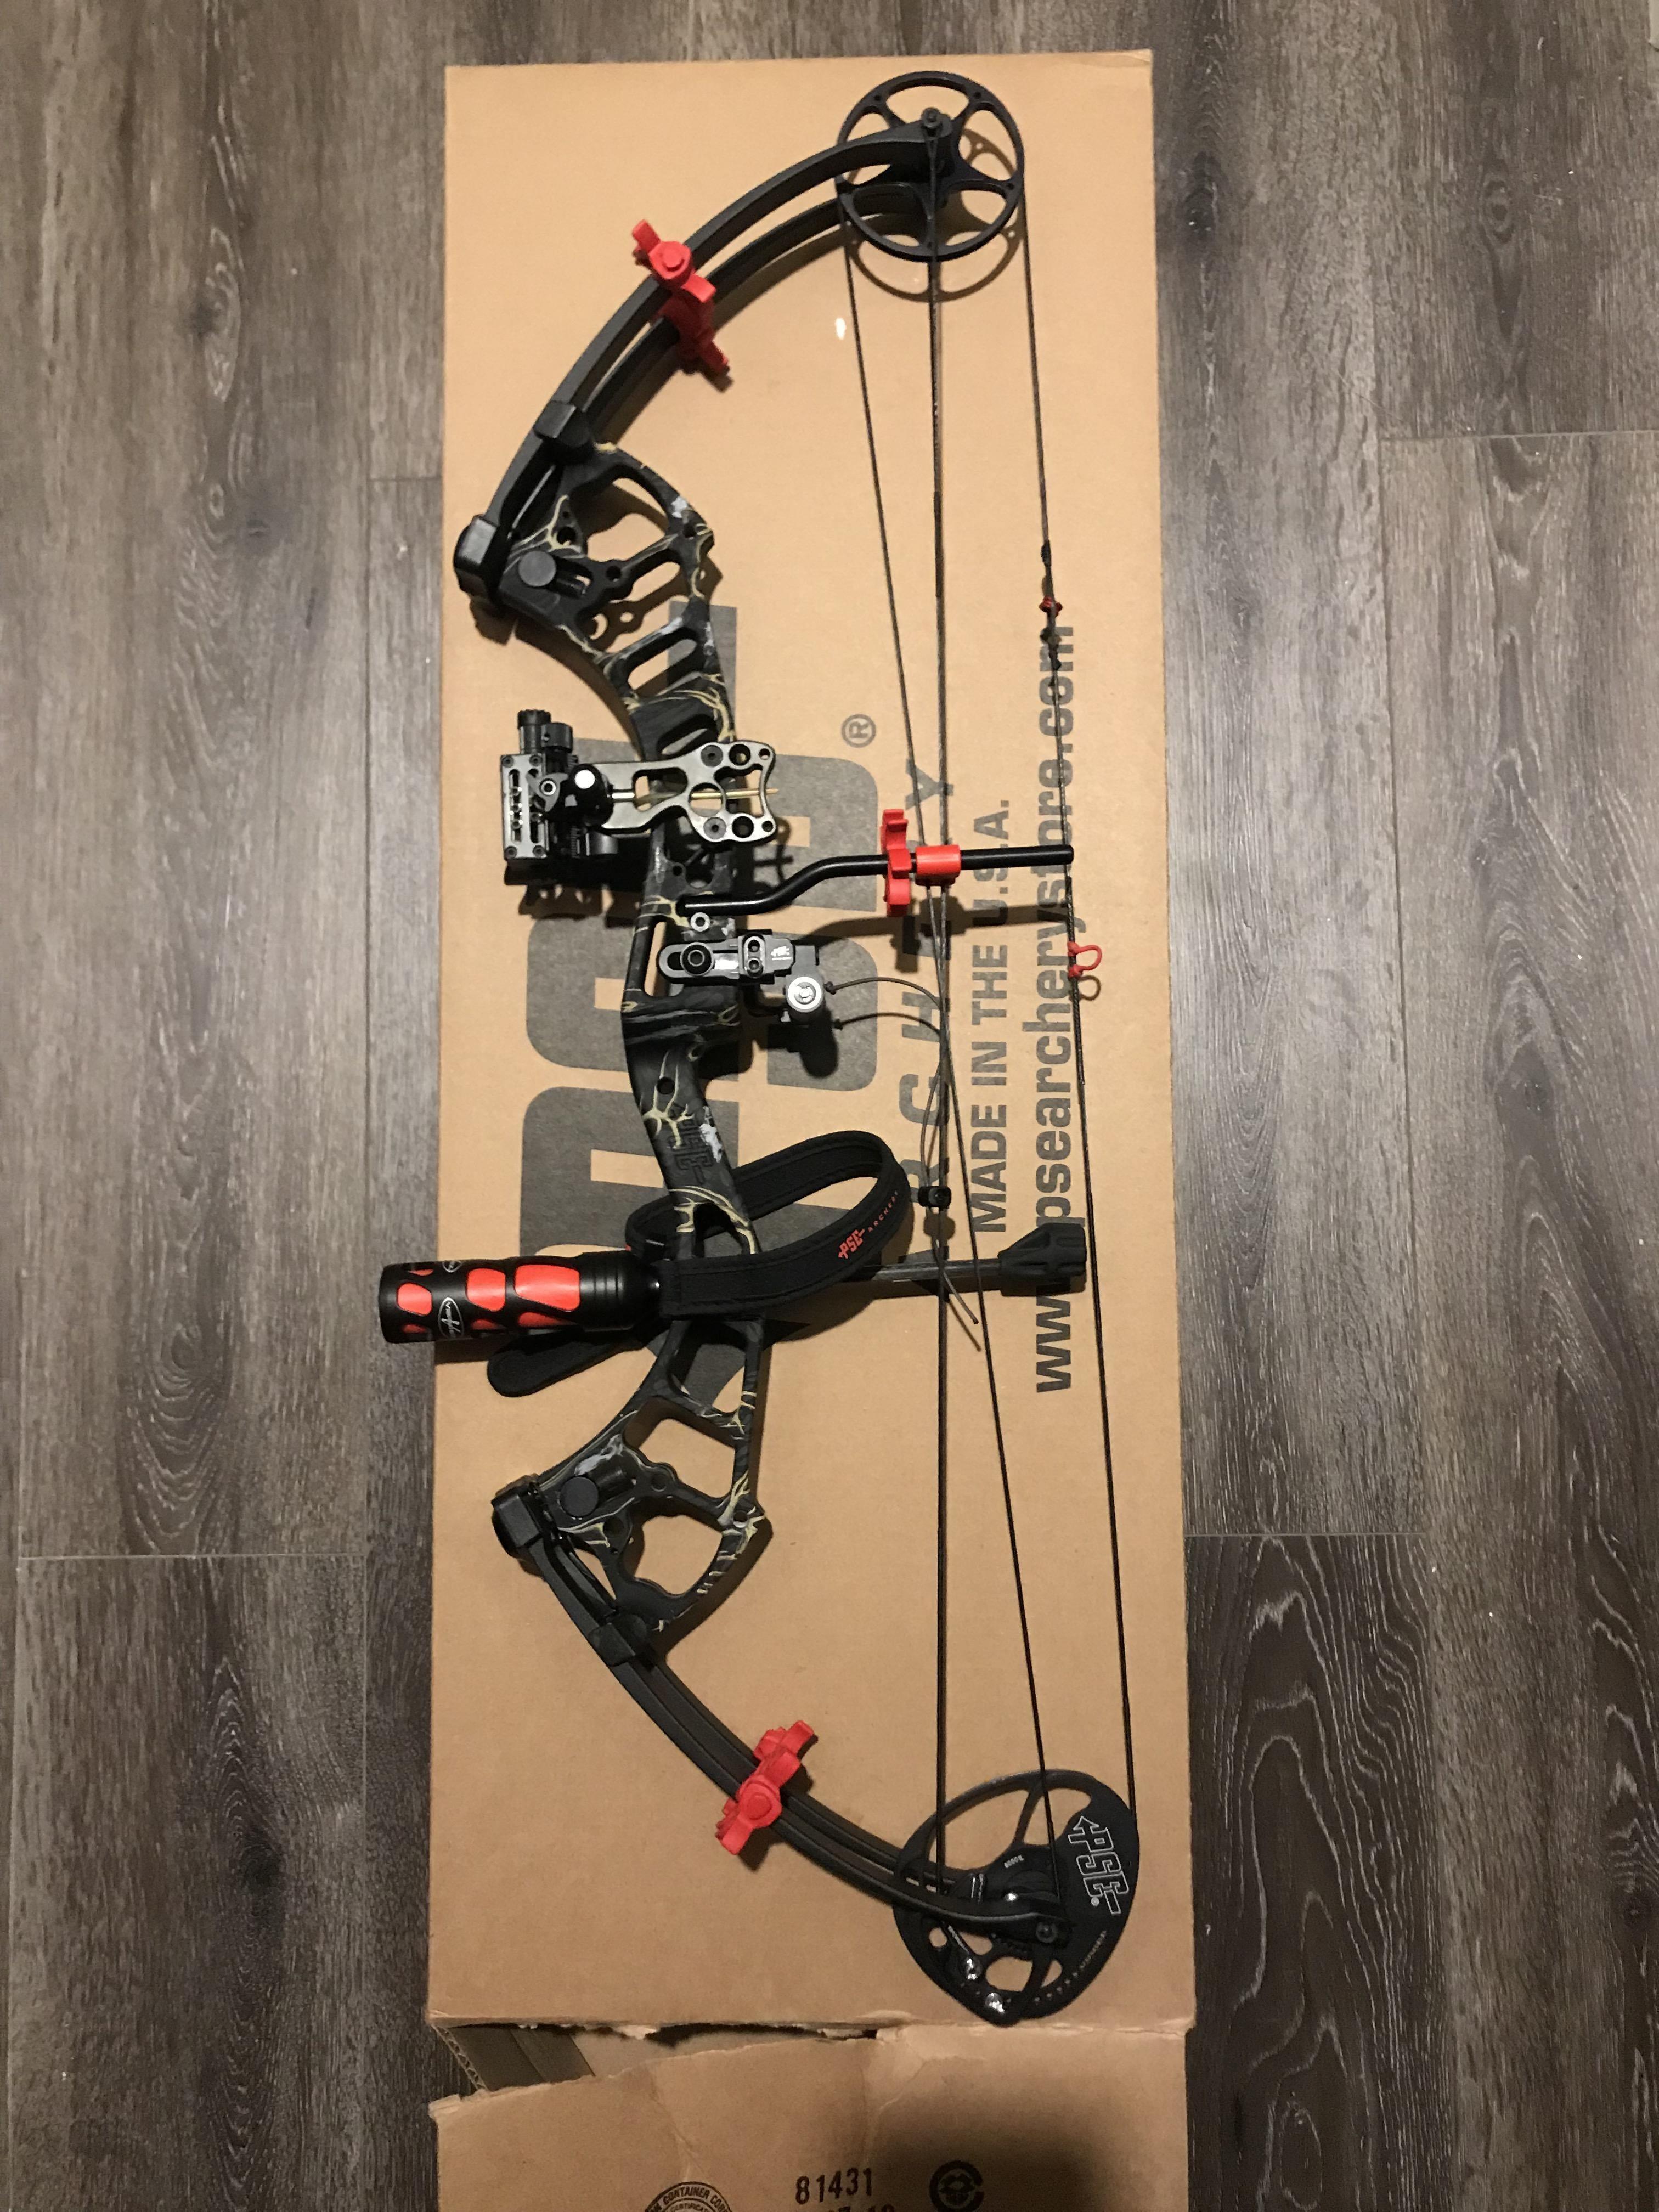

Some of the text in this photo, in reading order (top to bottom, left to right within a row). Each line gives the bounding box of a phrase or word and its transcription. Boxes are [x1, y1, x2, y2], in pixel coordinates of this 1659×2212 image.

[972, 945, 1008, 1025] THE
[1022, 626, 1086, 1392] wwpsearcherystore.com
[970, 1042, 1007, 1086] IN
[970, 1104, 1007, 1232] MADE
[838, 1229, 865, 1259] PSE
[1068, 1815, 1129, 1915] PSE
[663, 2186, 710, 2205] CONTAINER
[795, 2167, 872, 2205] 81431
